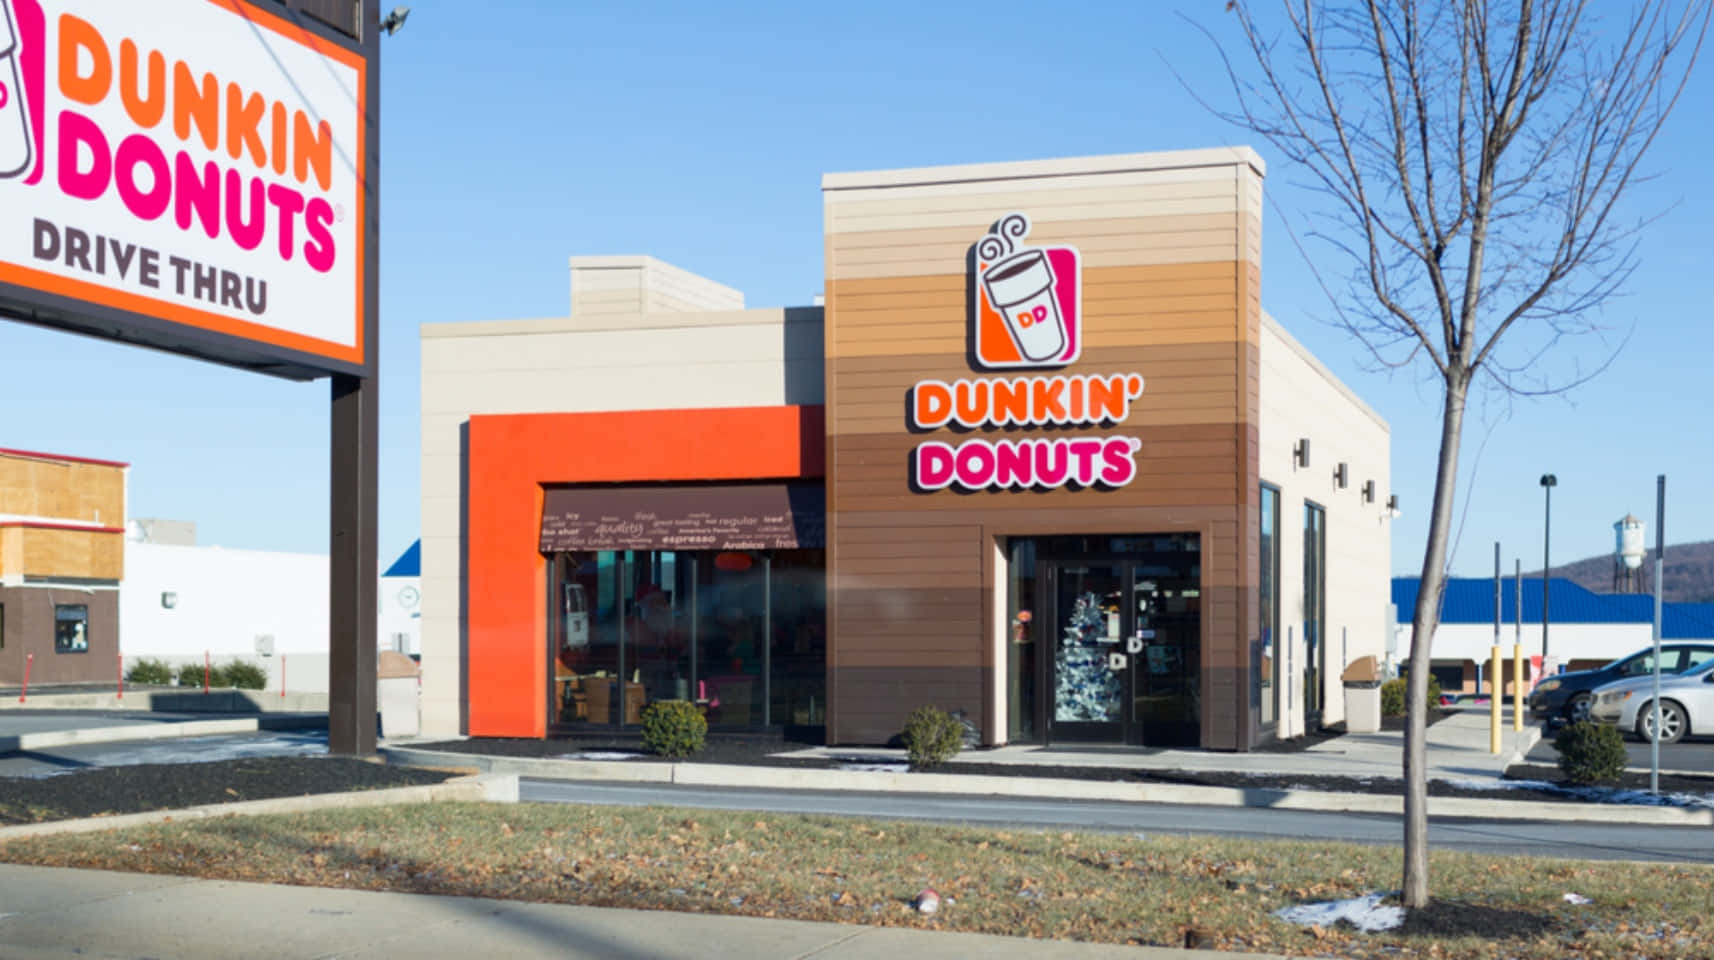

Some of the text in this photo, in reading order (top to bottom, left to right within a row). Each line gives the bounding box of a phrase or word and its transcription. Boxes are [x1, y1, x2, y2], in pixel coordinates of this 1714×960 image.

[58, 12, 332, 192] DUNKIN
[58, 109, 336, 273] DONUTS
[33, 216, 267, 316] DRIVE THRU
[1016, 304, 1048, 329] DD
[916, 376, 1141, 425] DUNKIN'
[918, 439, 1133, 487] DONUTS
[662, 535, 716, 545] espresso
[719, 516, 758, 527] regular
[722, 541, 765, 550] Arabica
